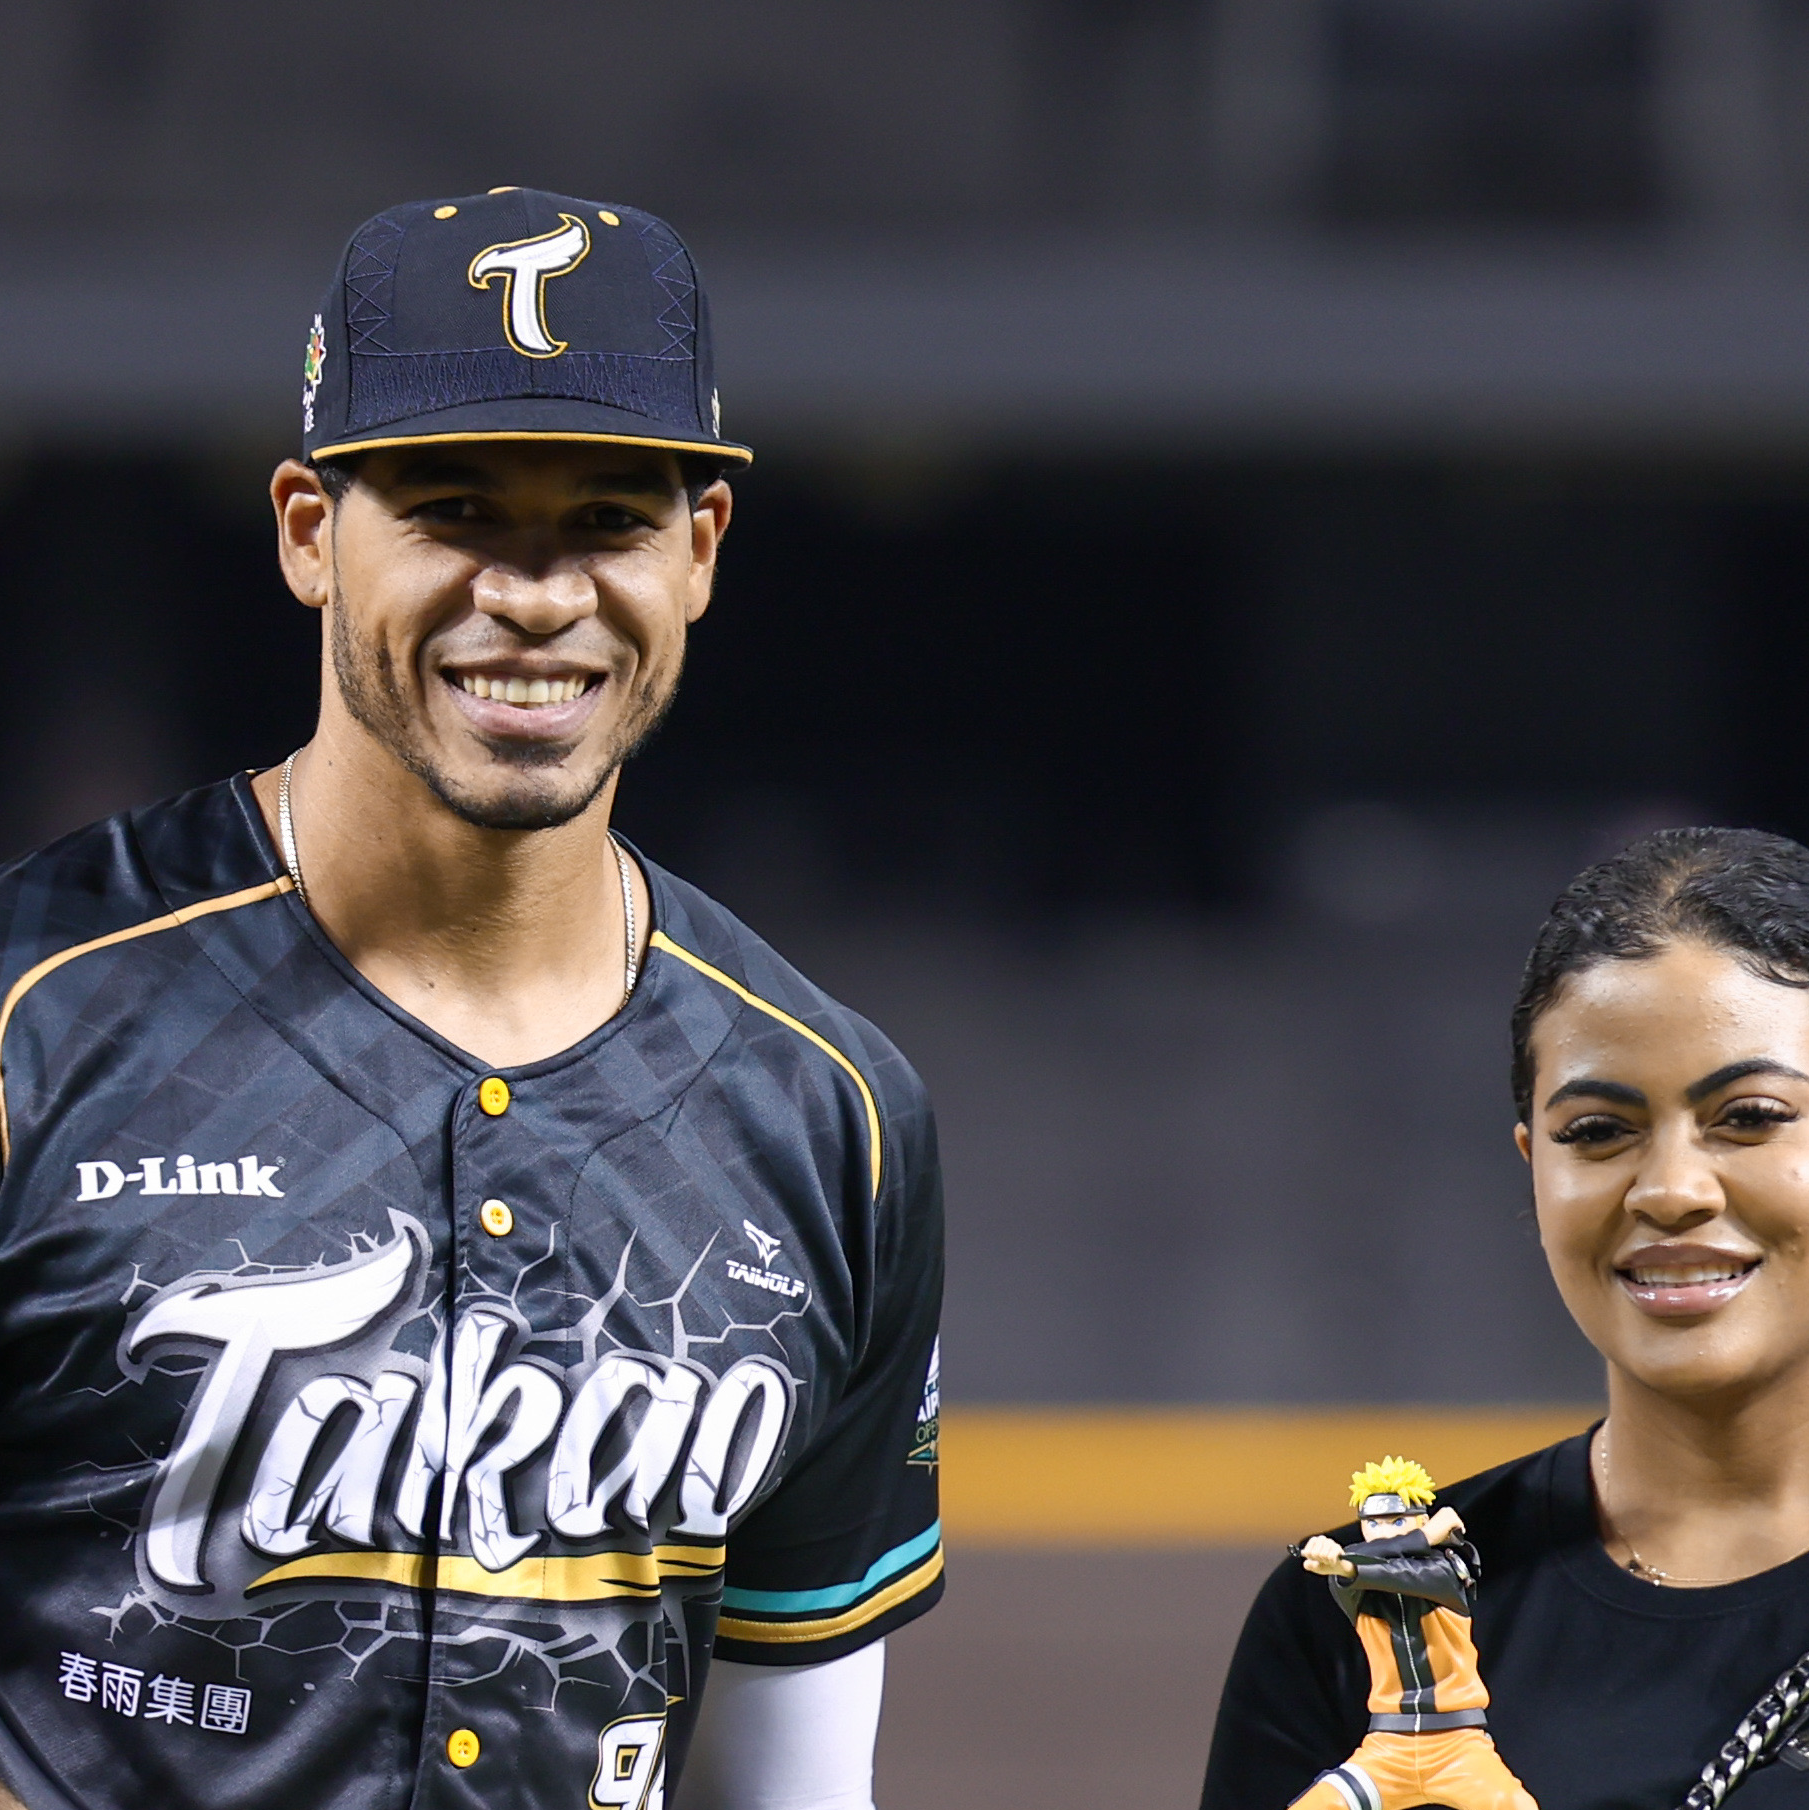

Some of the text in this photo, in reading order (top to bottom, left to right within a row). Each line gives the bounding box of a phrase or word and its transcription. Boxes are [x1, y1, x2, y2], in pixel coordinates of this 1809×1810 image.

[468, 213, 591, 359] T
[76, 1154, 286, 1201] D-Link
[725, 1259, 806, 1298] TAIWOLF
[128, 1226, 792, 1592] Takao
[58, 1651, 253, 1735] 春雨集團
